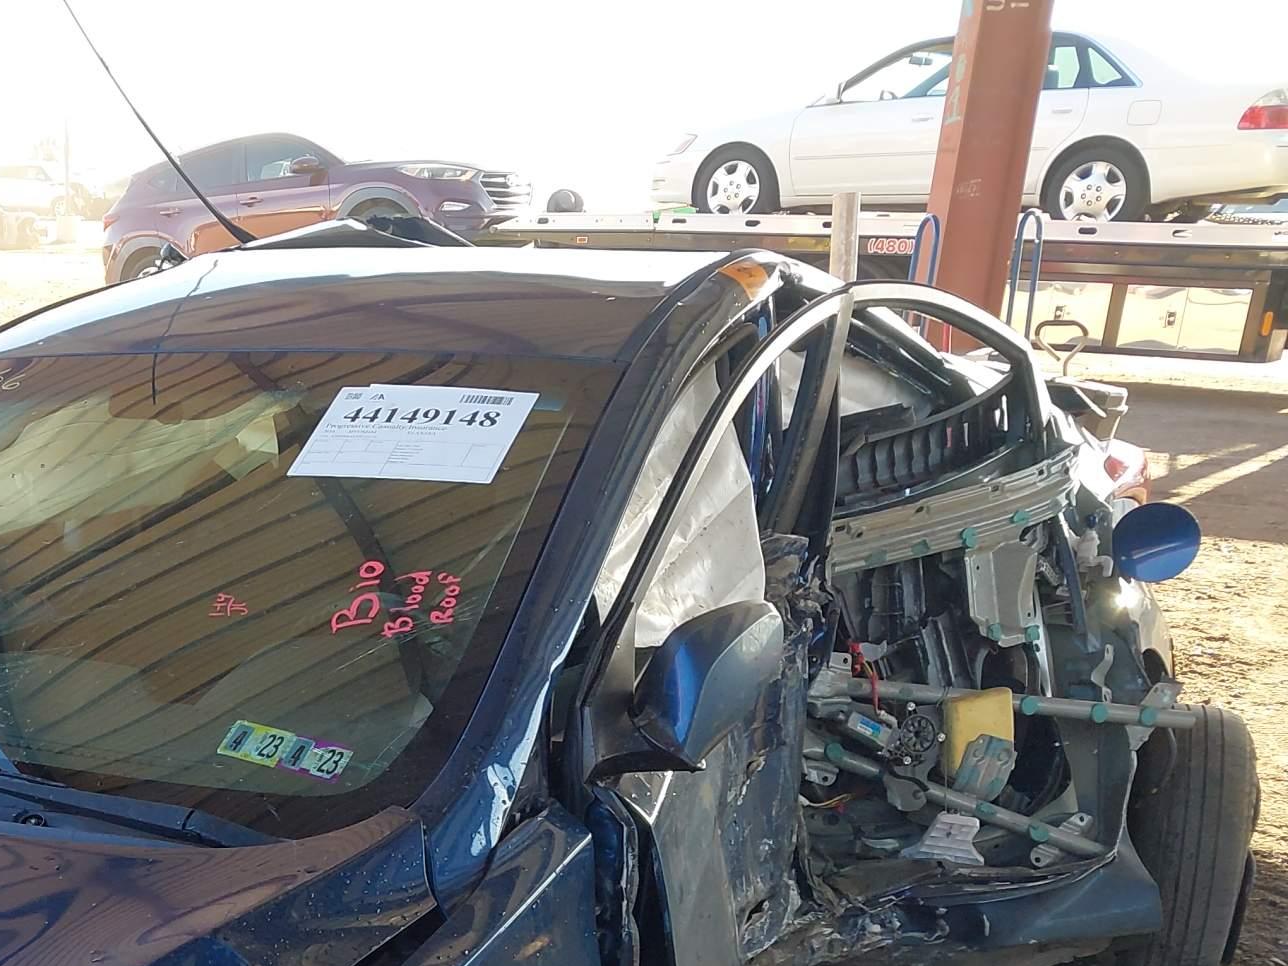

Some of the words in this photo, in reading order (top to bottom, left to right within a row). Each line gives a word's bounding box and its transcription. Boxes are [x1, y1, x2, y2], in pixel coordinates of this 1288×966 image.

[868, 238, 915, 254] (480)
[344, 407, 501, 428] 44149148
[230, 730, 249, 752] 4
[256, 734, 285, 759] 23
[290, 745, 307, 767] 4
[316, 749, 344, 775] 23
